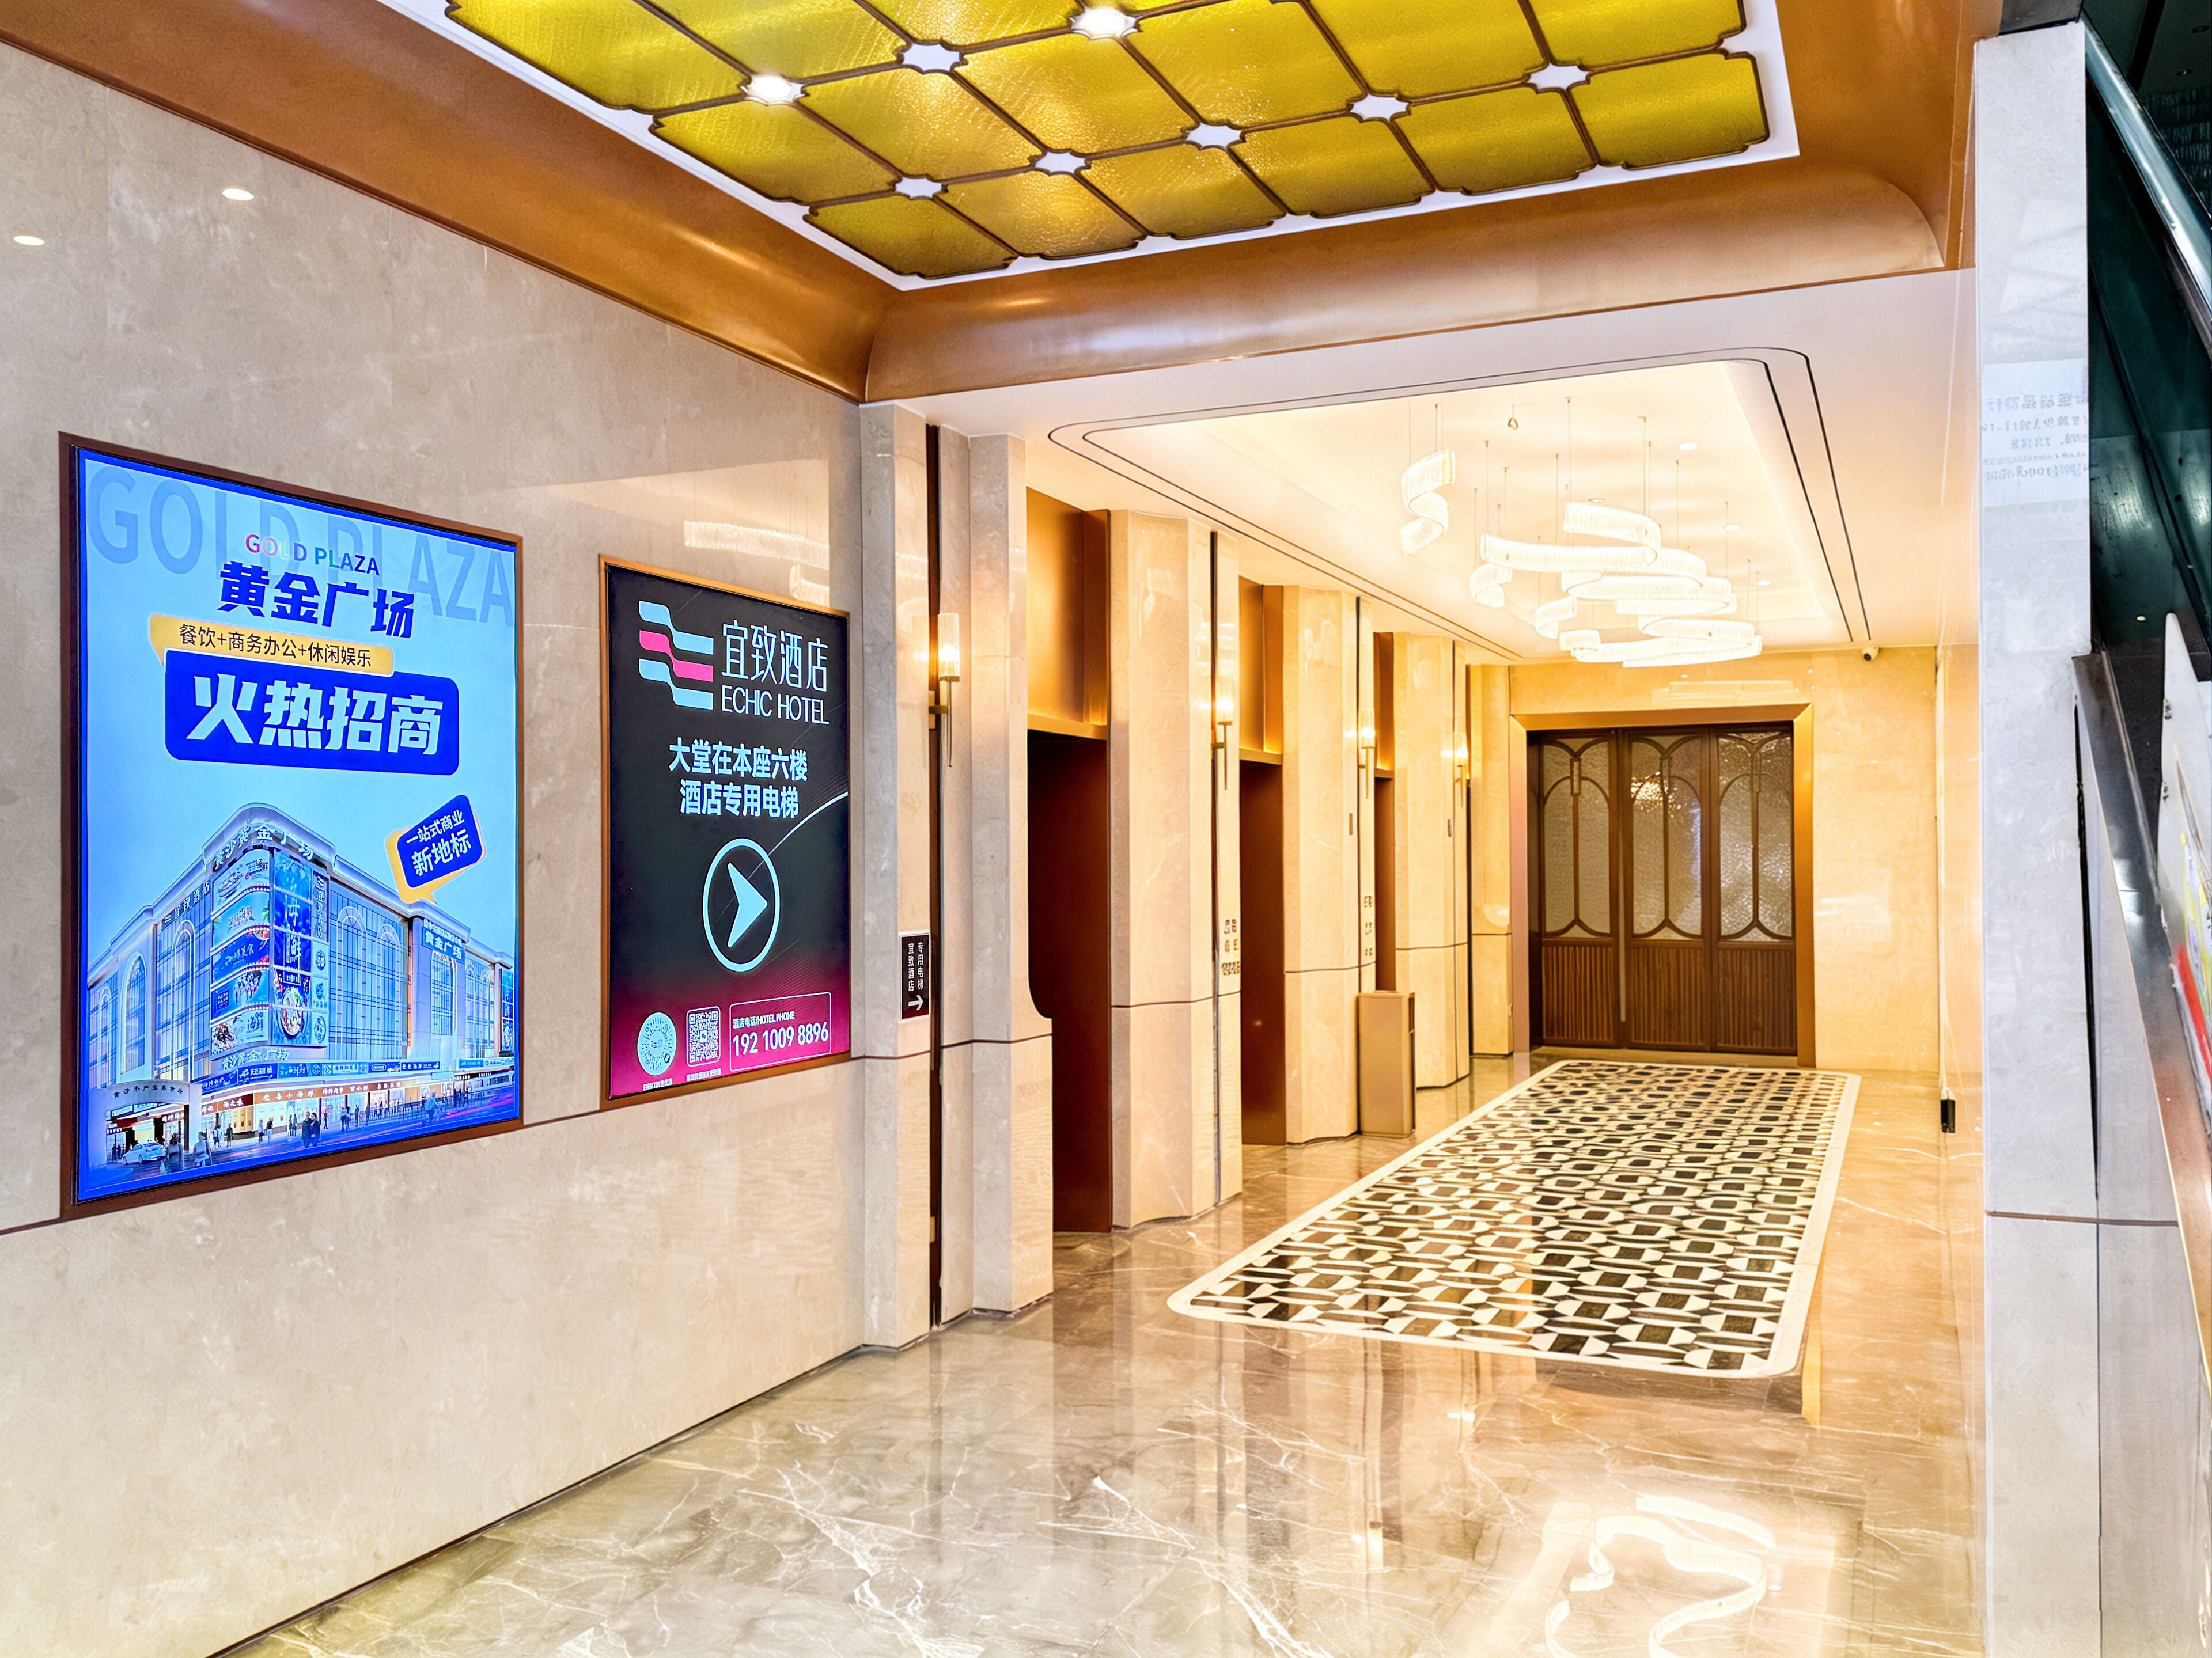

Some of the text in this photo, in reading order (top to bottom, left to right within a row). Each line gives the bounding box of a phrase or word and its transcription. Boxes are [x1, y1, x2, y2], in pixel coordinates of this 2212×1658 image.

[245, 534, 380, 576] GOLD PLAZA
[216, 560, 415, 639] 黄金广场
[179, 624, 372, 668] 餐饮+商务办公+休闲娱乐
[721, 620, 828, 692] 宜致酒店
[186, 673, 444, 756] 火热招商
[722, 685, 830, 725] ECHIC HOTEL
[669, 737, 808, 781] 大堂在本座六楼
[680, 779, 799, 818] 酒店专用电梯
[406, 809, 465, 844] 一站式商业
[411, 828, 472, 877] 新地标
[425, 931, 462, 960] 黄金广场
[732, 1011, 796, 1029] 酒店电话/HOTEL PHONE
[732, 1021, 830, 1056] 192 1009 8896
[222, 1048, 290, 1070] 黄沙黄金广场
